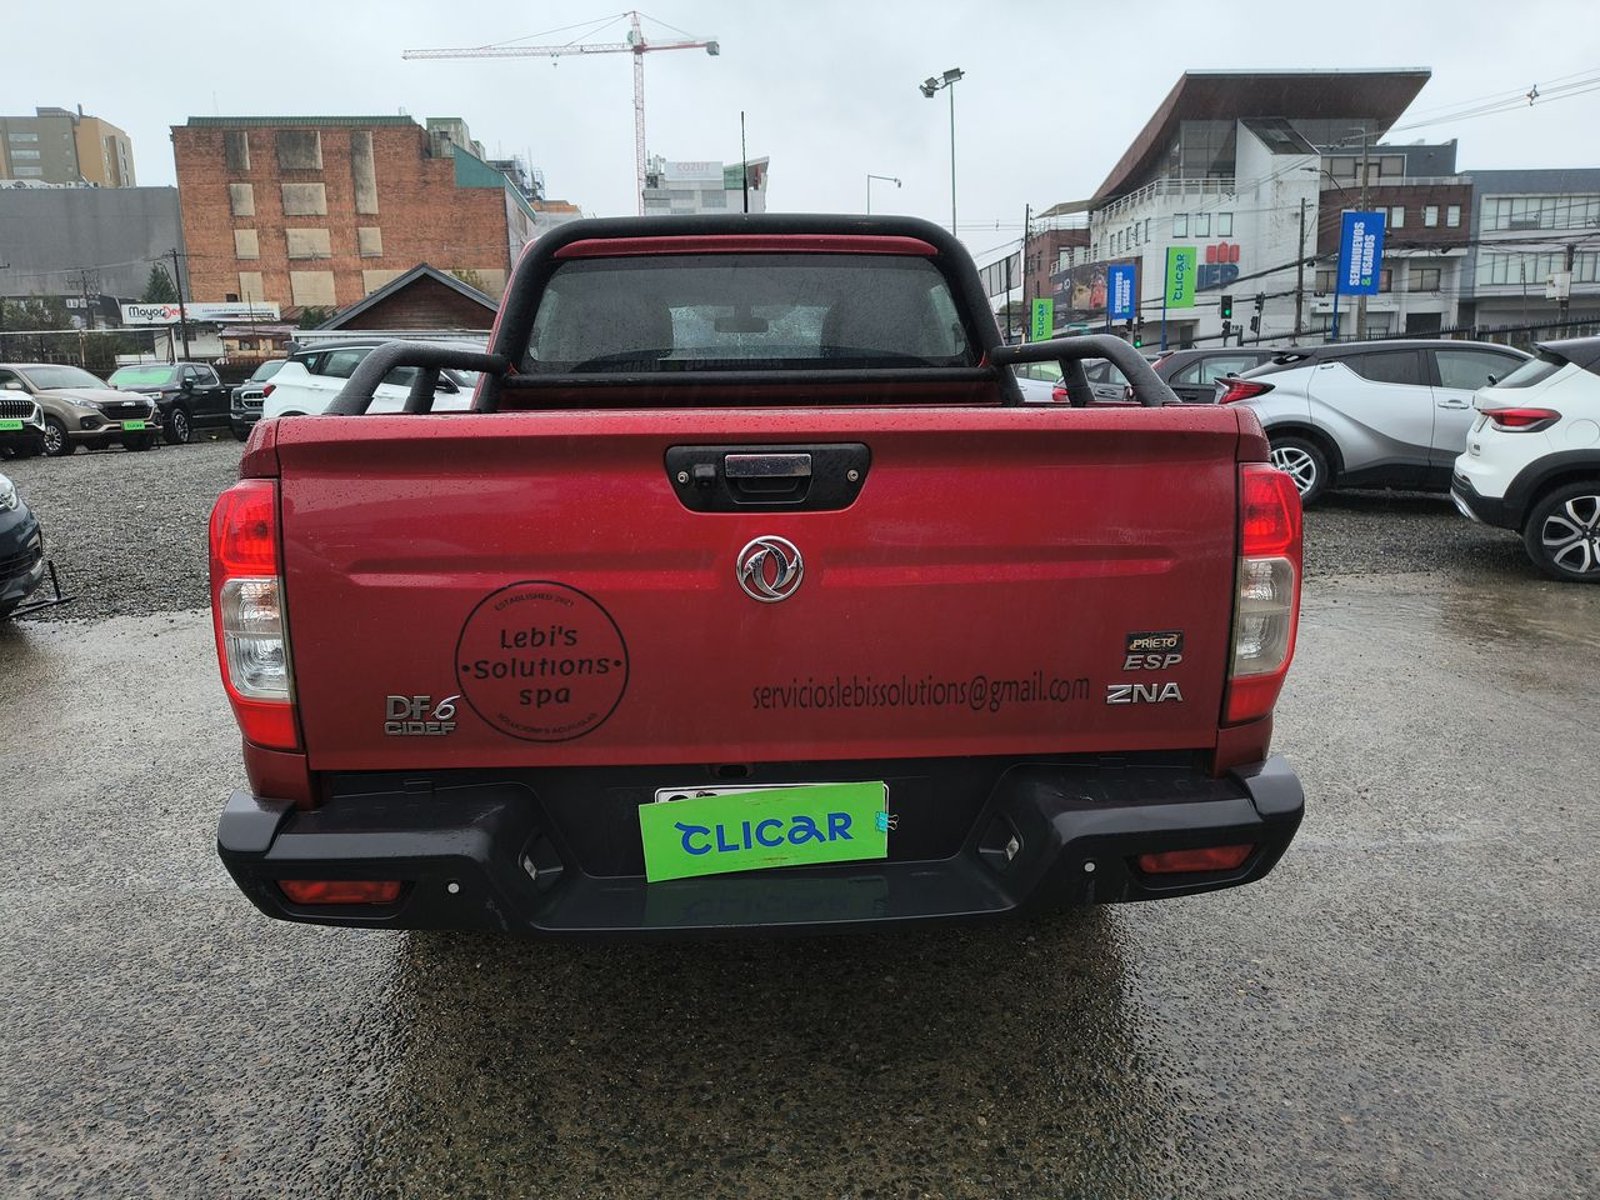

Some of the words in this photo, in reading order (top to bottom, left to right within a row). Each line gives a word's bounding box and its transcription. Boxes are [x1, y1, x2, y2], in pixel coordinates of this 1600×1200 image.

[1349, 222, 1365, 286] SEMINUEVOS
[1361, 234, 1375, 275] USADOS
[1361, 276, 1371, 286] &
[500, 626, 578, 649] Lebi's
[1132, 637, 1177, 649] PRIETO
[474, 657, 610, 680] Solutions
[1123, 654, 1182, 671] ESP
[519, 687, 571, 708] spa
[753, 671, 1090, 712] servicioslebissolutions@gmail.com
[1106, 682, 1183, 704] ZNA
[384, 721, 456, 736] CIDEF
